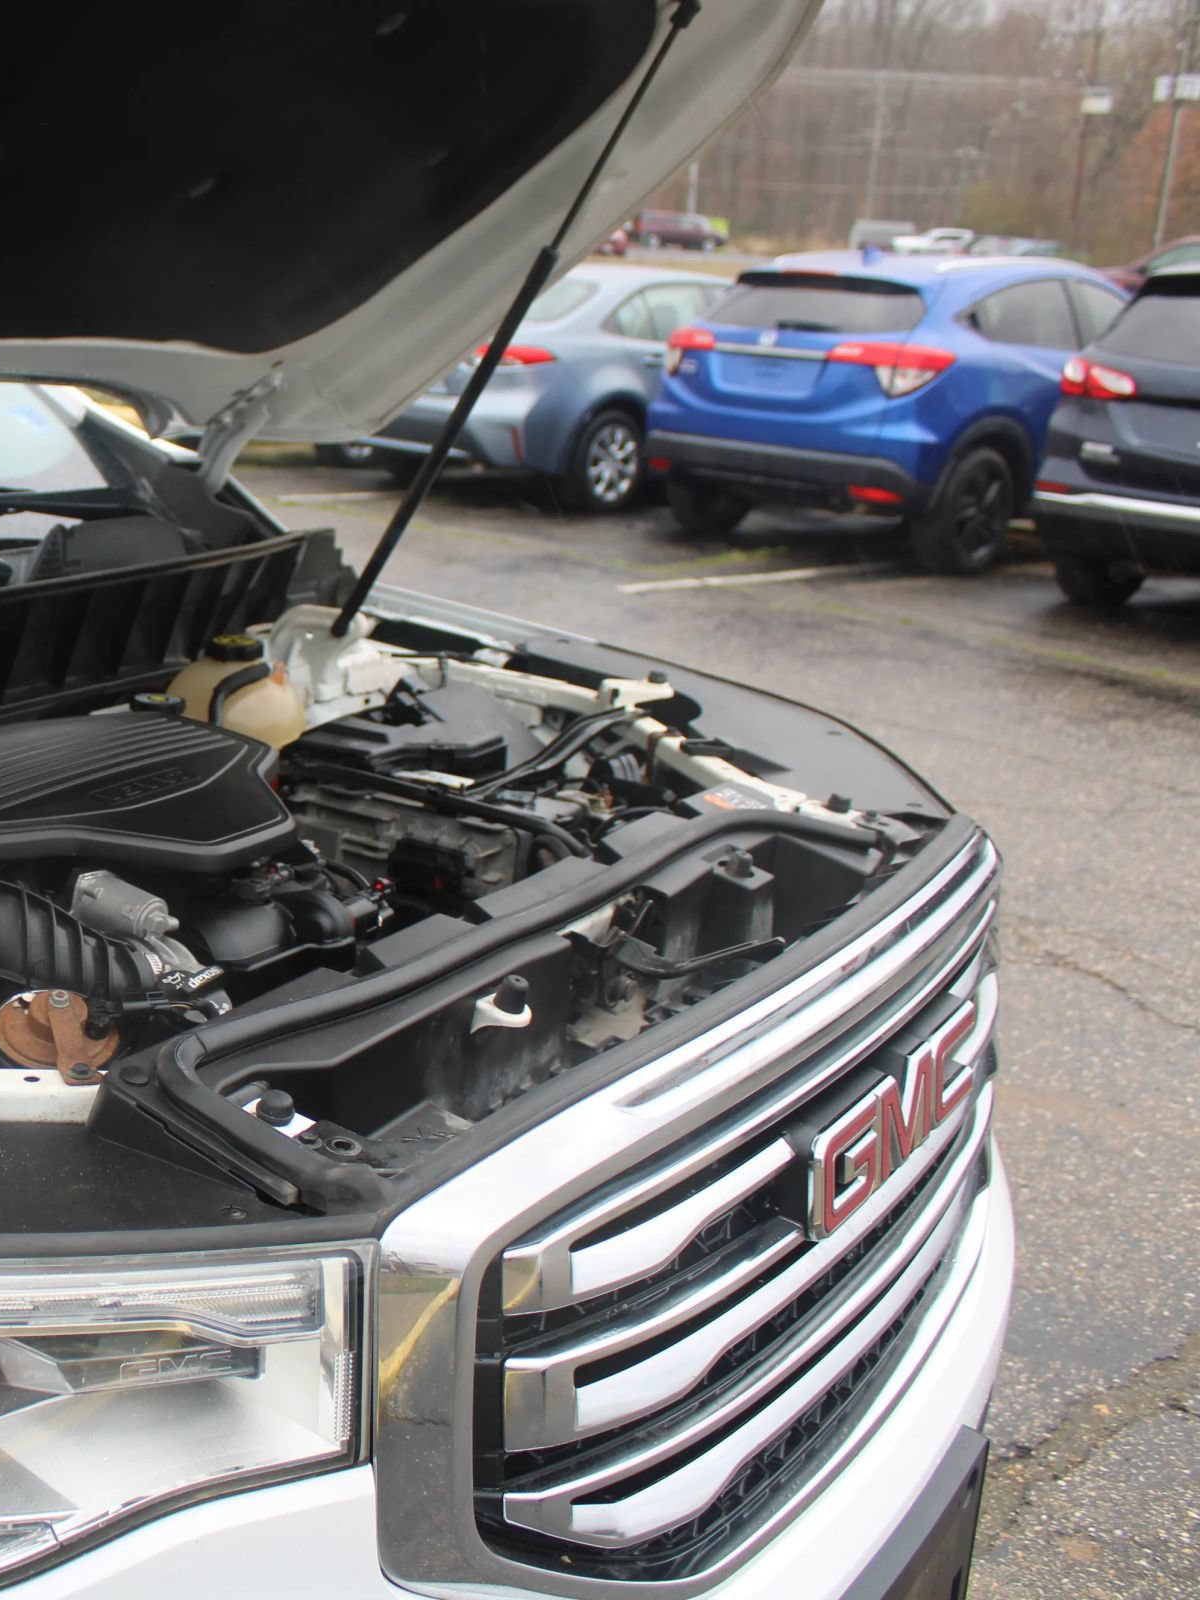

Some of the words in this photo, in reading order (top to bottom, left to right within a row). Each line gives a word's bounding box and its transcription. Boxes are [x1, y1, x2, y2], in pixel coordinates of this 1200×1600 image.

[187, 967, 222, 990] dexos
[808, 999, 975, 1241] GMC
[119, 1349, 232, 1383] GMC
